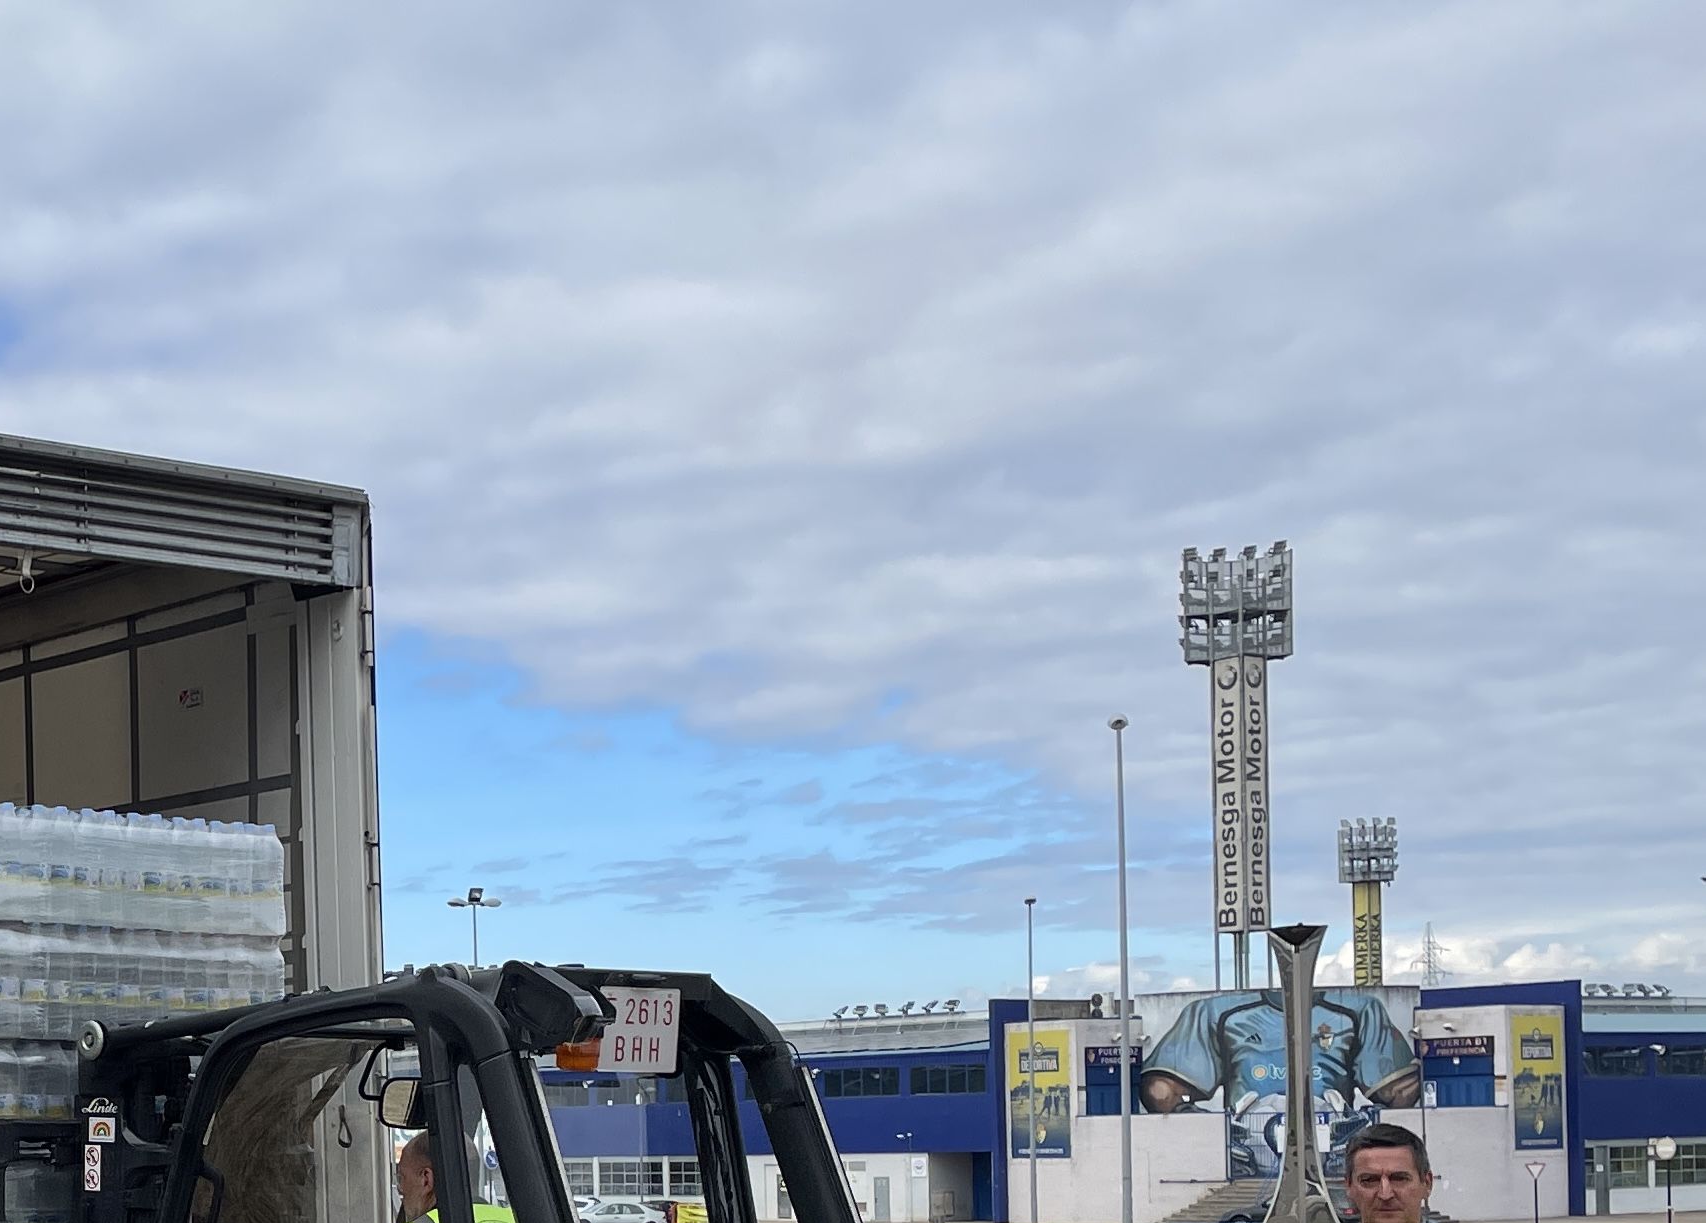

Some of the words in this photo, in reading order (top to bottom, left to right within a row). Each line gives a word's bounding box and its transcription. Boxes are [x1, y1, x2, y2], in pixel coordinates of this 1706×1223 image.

[1217, 697, 1235, 784] Motor
[1246, 695, 1262, 782] Motor
[1218, 790, 1239, 928] Bernesga
[1249, 789, 1266, 926] Bernesga
[625, 998, 673, 1026] 2613
[614, 1035, 660, 1063] BHH
[1098, 1047, 1122, 1056] PUERT
[1020, 1059, 1058, 1072] DEORTIVA
[81, 1097, 119, 1114] Linde
